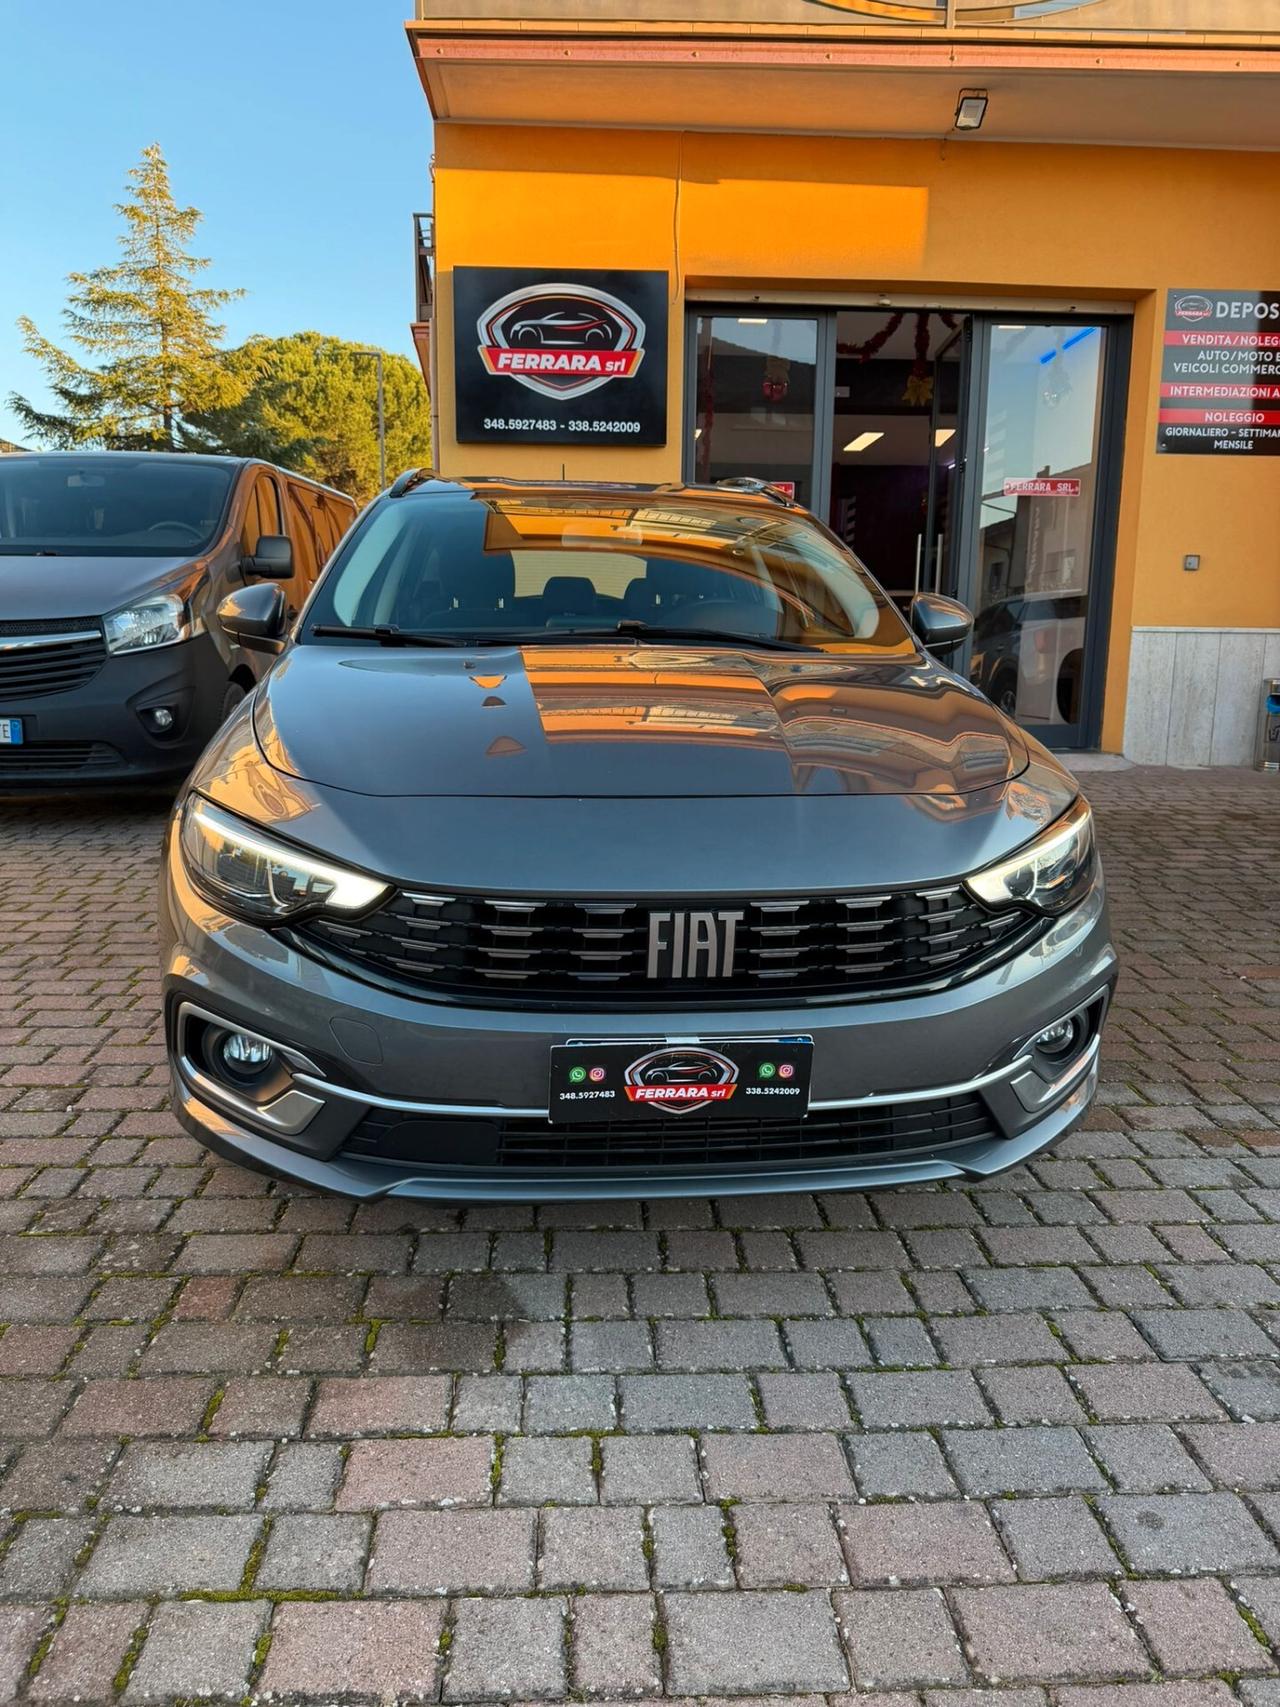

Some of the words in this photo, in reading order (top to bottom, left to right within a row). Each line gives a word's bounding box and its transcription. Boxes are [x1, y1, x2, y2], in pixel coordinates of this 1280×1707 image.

[1182, 333, 1280, 346] VENDITA/NOLEG
[498, 353, 601, 371] FERRARA
[605, 358, 626, 372] srl
[1173, 362, 1219, 374] VEICOLI
[1170, 386, 1270, 398] INTERMEDIAZIONI
[1204, 412, 1265, 423] NOLEGGIO
[484, 418, 557, 431] 348.5927483
[568, 420, 641, 433] 338.5242009
[1165, 427, 1229, 437] GIORNALIERO
[1213, 440, 1254, 450] MENSILE
[1009, 482, 1052, 492] FERRARA
[1056, 482, 1074, 492] SRL
[647, 911, 744, 978] FIAT
[559, 1090, 616, 1101] 348.5927483
[635, 1087, 709, 1099] FERRARA
[711, 1089, 726, 1098] srl
[745, 1086, 801, 1096] 338.5242009
